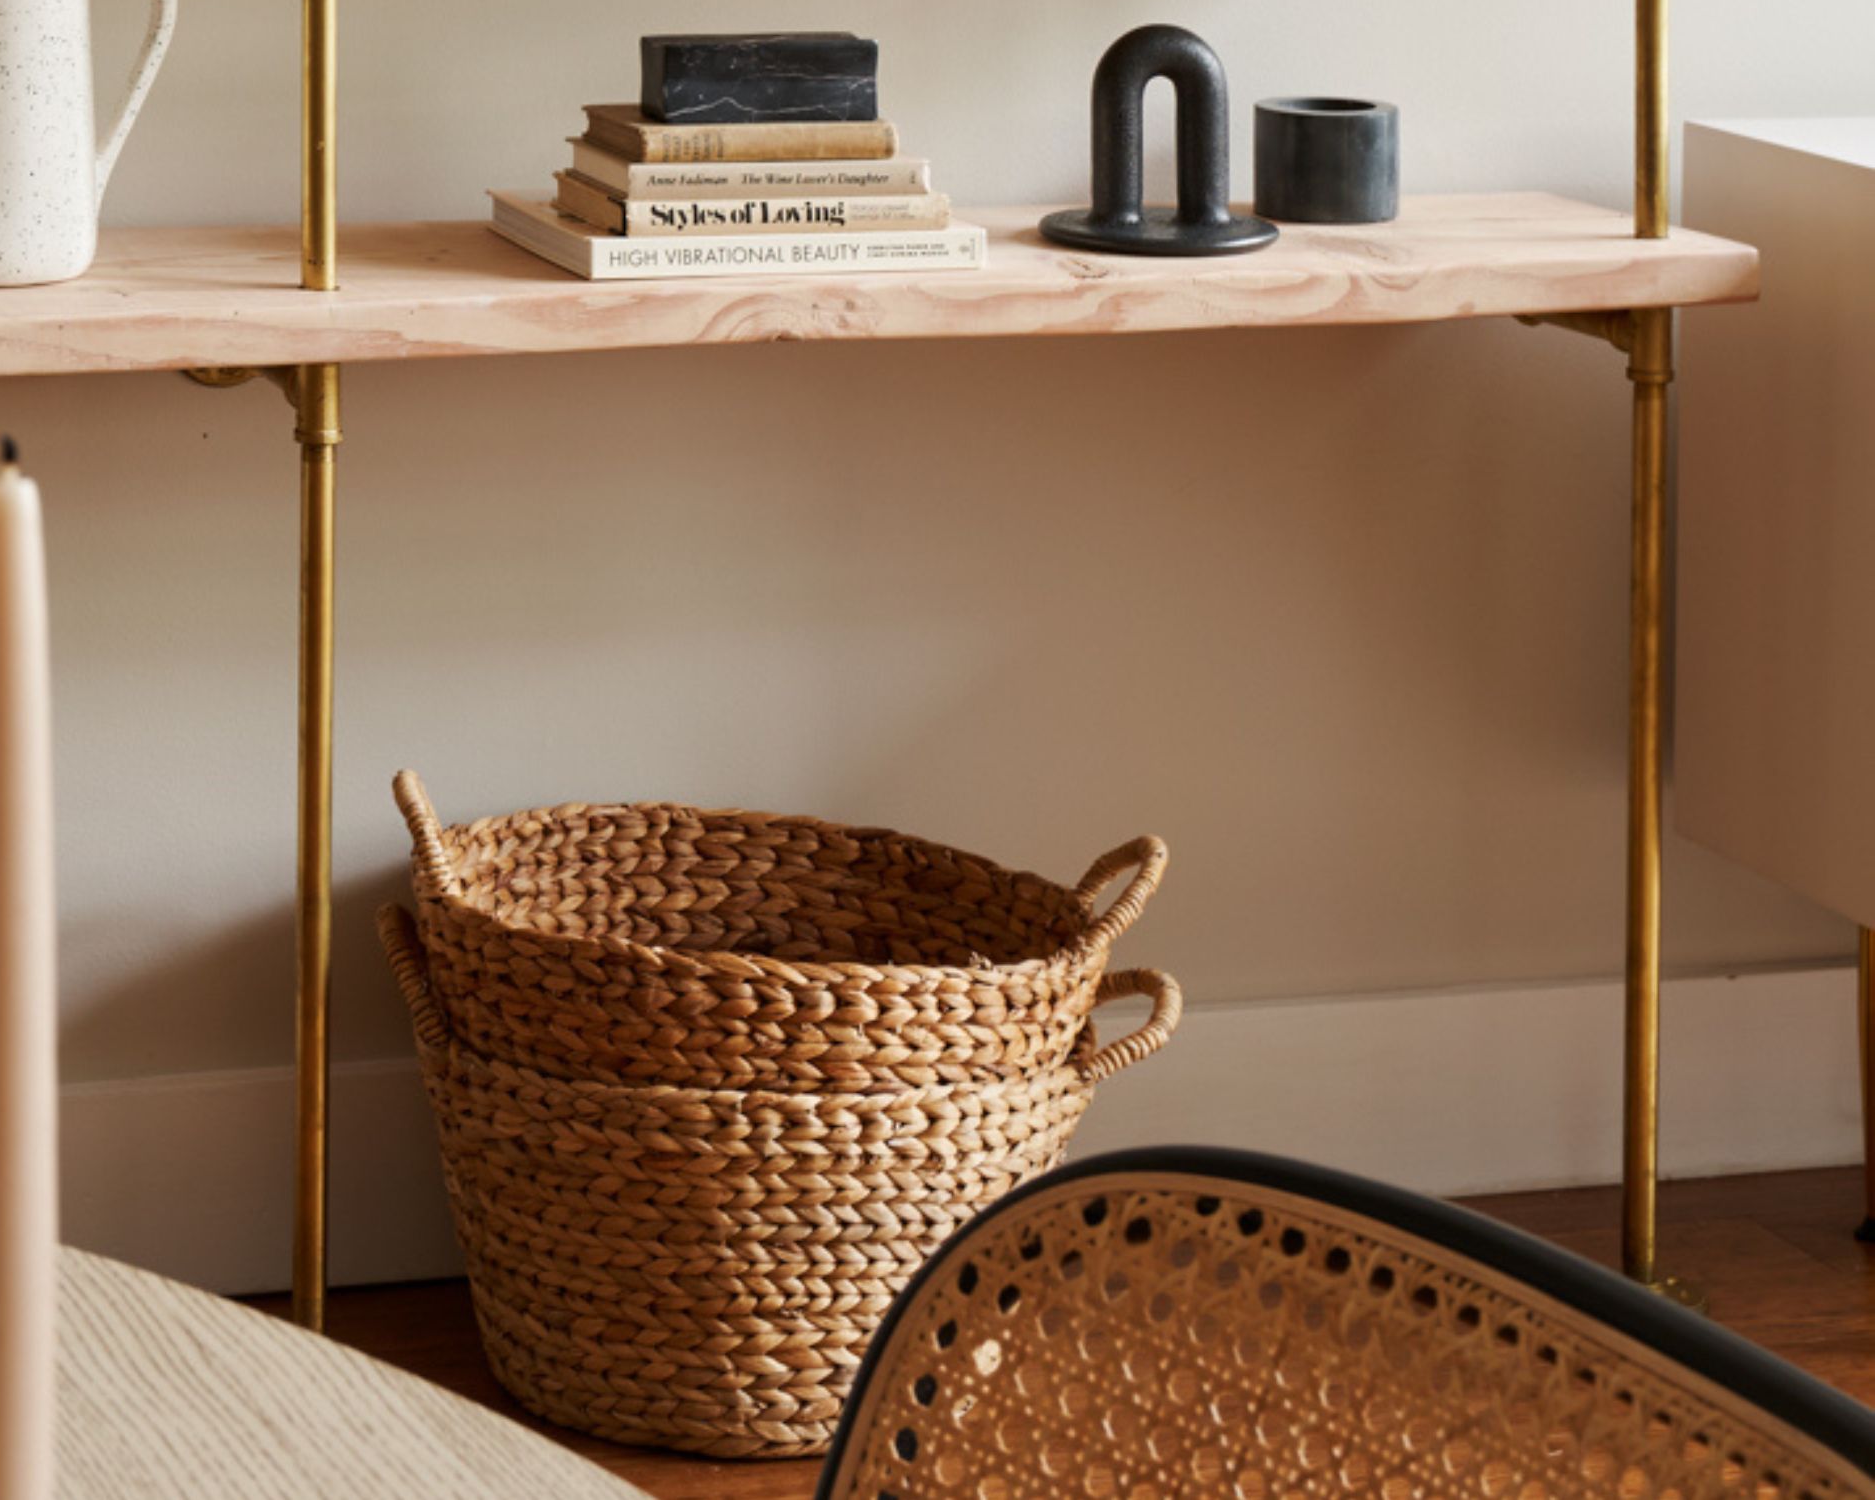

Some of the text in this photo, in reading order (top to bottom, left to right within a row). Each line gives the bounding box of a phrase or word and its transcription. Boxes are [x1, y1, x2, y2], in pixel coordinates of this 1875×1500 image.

[646, 174, 676, 186] Anne
[741, 173, 762, 185] The
[650, 203, 726, 230] Styles
[730, 202, 756, 225] of
[761, 200, 845, 227] Loving
[608, 248, 658, 268] HIGH
[664, 246, 784, 266] VIBRATIONAL
[792, 243, 861, 262] BEAUTY
